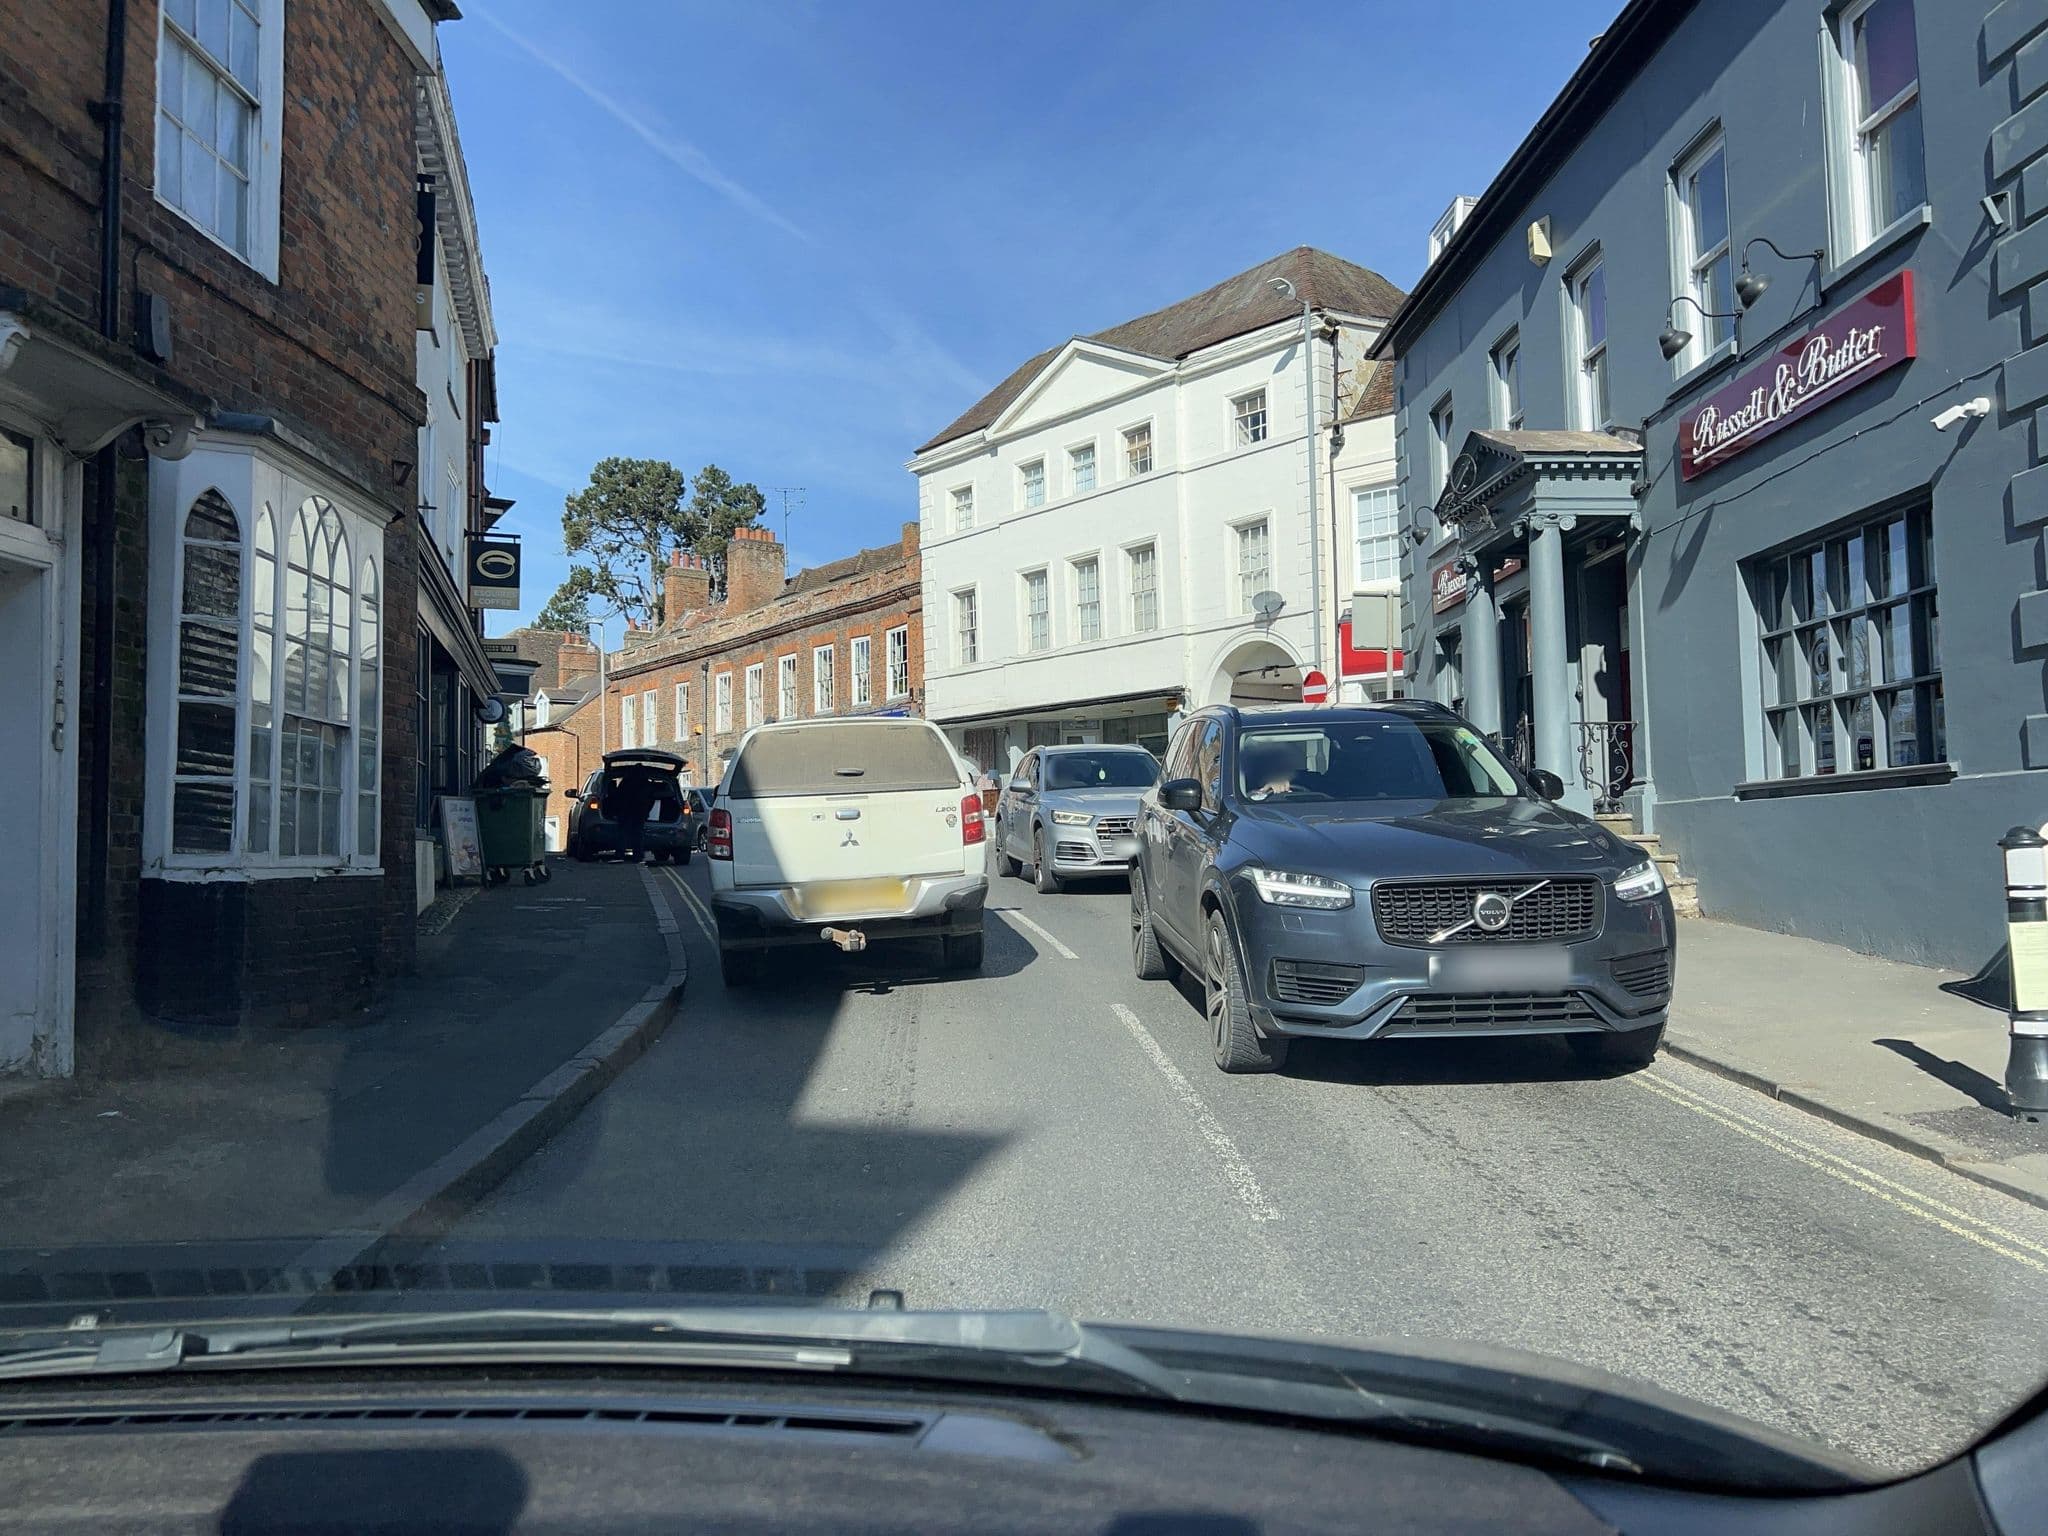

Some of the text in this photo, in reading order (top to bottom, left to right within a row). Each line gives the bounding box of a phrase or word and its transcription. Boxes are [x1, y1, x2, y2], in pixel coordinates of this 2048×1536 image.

[1693, 325, 1885, 456] Russell & Butler
[478, 598, 512, 606] COFFEE
